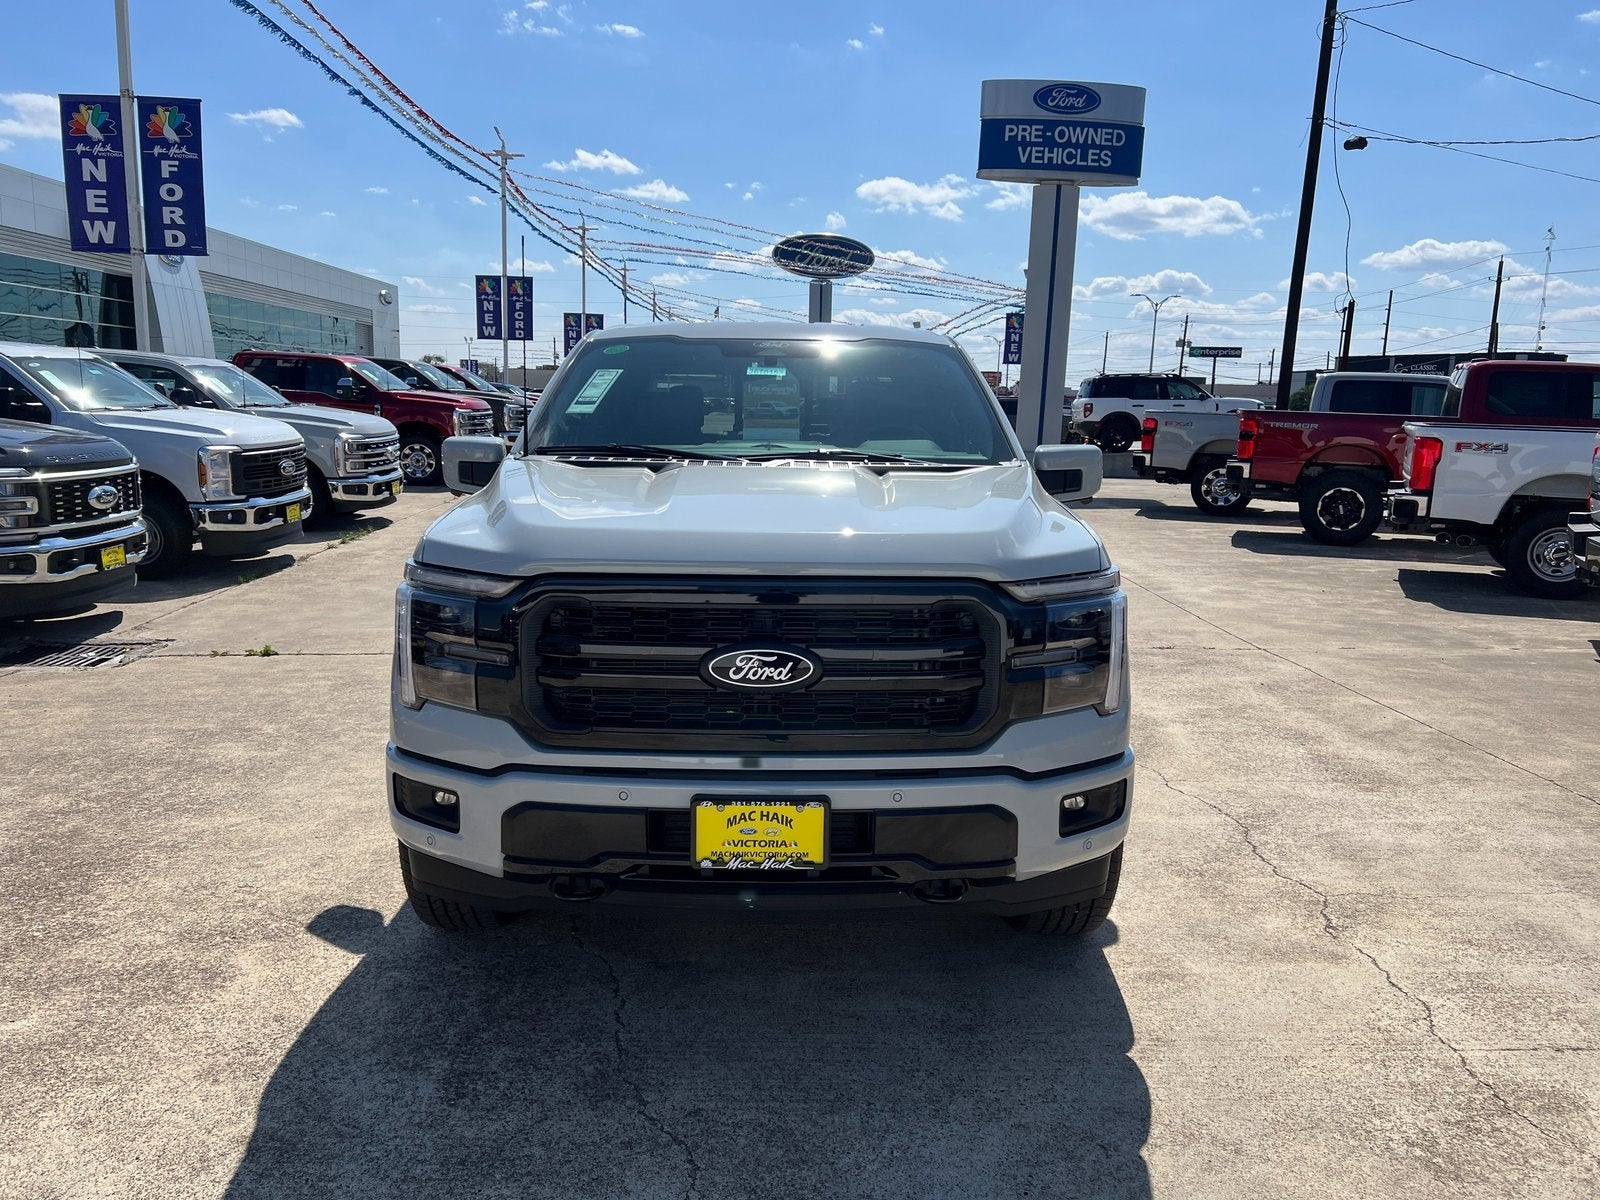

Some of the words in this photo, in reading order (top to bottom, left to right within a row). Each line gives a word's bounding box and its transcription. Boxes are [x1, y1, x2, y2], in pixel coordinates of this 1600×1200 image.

[1048, 88, 1086, 108] Ford
[1004, 124, 1126, 147] PRE-OWNED
[1018, 146, 1112, 167] VEHICLES
[81, 158, 116, 245] NEW
[159, 160, 187, 247] FORD
[482, 300, 496, 337] NEW
[514, 302, 525, 338] FORD
[568, 330, 577, 352] NE
[1008, 333, 1020, 362] NEW
[1192, 348, 1241, 356] enterprise
[1269, 421, 1319, 430] TREMOR
[1455, 442, 1509, 452] FX4
[729, 654, 794, 681] Ford
[727, 810, 756, 829] MAC
[760, 810, 794, 830] HAIK
[732, 840, 788, 848] VICTORIA
[711, 851, 809, 859] MACHAIKVICTORIA.COM
[725, 857, 755, 869] Mac
[760, 857, 796, 869] Haik
